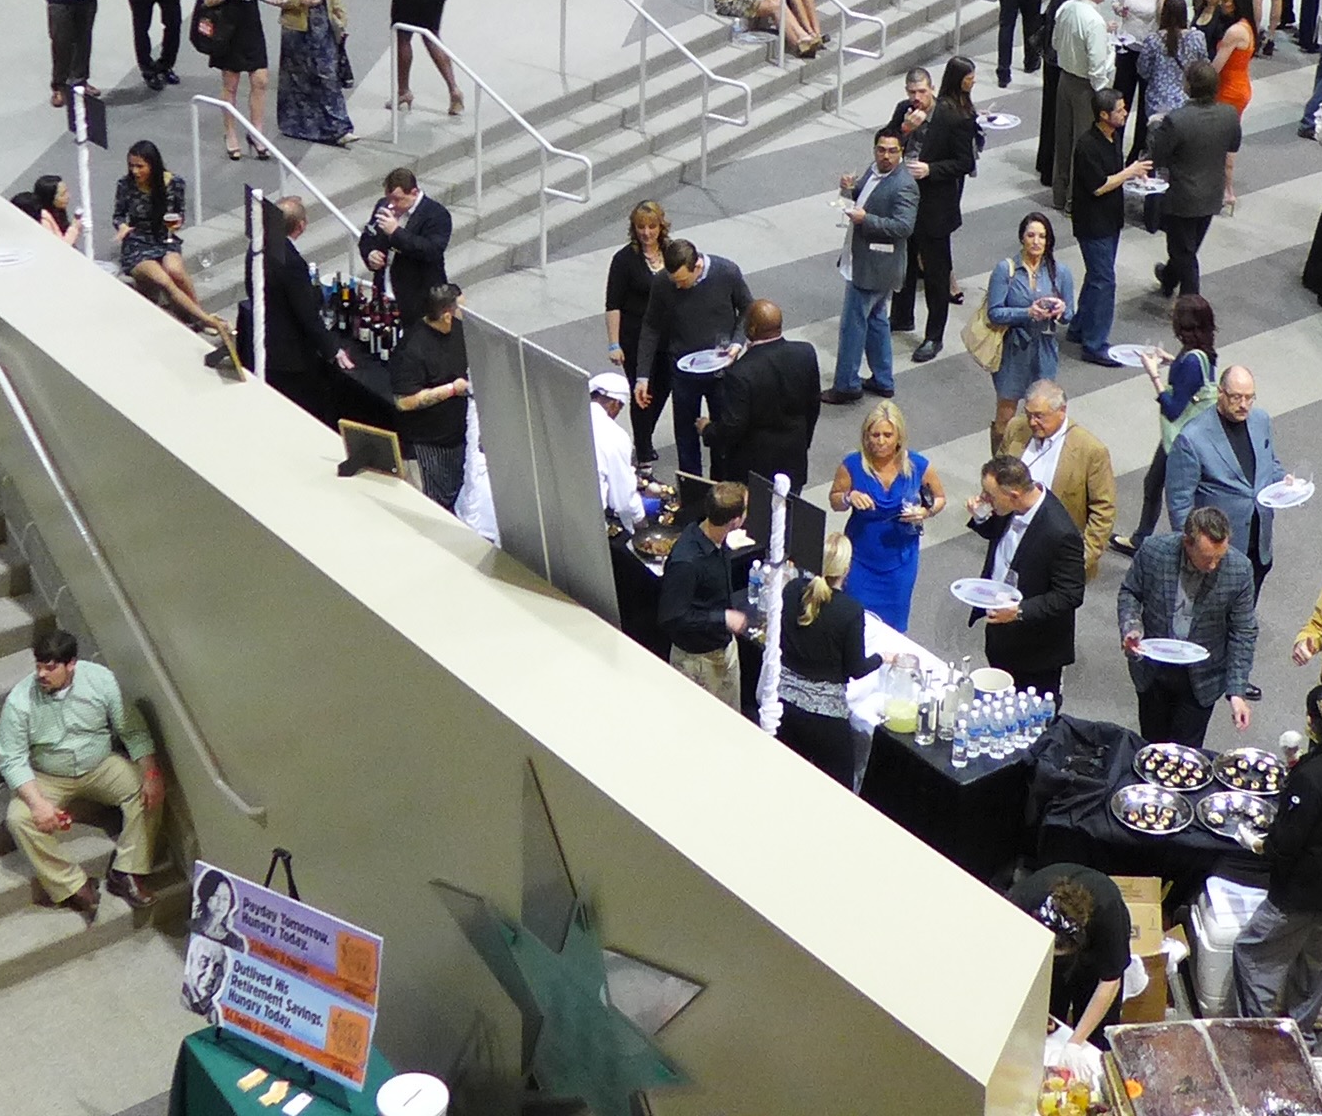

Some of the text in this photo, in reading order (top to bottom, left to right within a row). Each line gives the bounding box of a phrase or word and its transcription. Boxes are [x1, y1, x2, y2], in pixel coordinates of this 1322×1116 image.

[241, 912, 309, 951] Hungry Today.
[243, 896, 329, 945] Payday Tomorrow.
[233, 959, 289, 995] Outlived His
[227, 988, 262, 1015] Hungry
[264, 1005, 292, 1029] Today.
[230, 973, 284, 1009] Retirement
[286, 998, 323, 1027] Savings.
